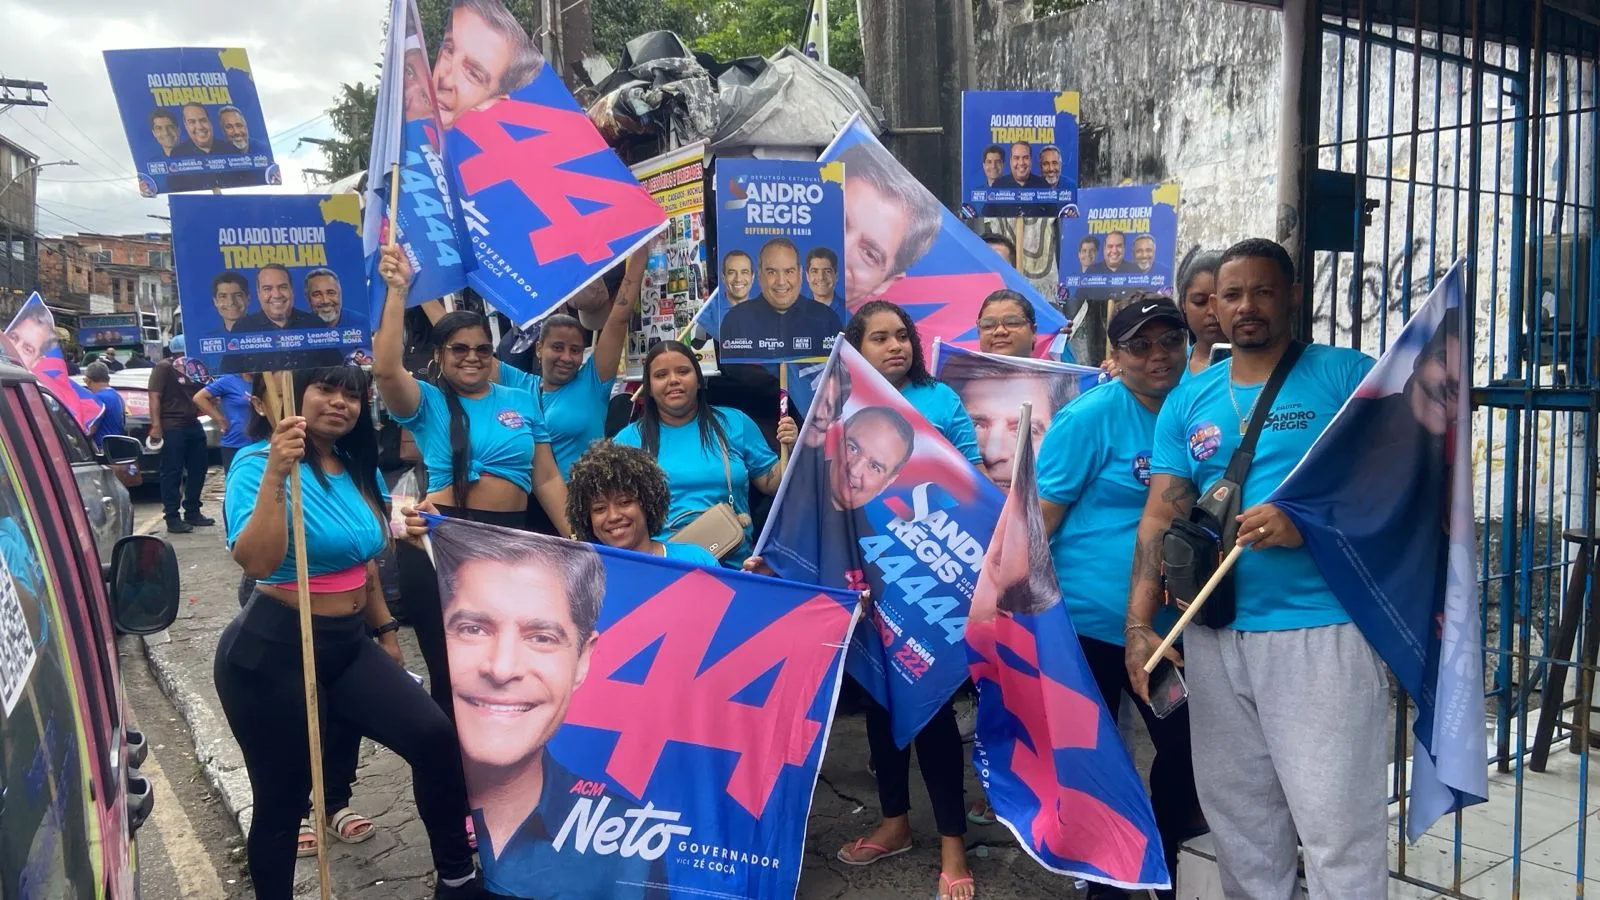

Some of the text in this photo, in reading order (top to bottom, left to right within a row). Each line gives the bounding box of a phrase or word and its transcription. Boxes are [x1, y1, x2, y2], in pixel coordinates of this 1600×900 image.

[148, 72, 228, 87] AO LADO DE QUEM
[151, 87, 233, 106] TRABALHA
[991, 115, 1055, 128] AO LADO DE QUEM
[991, 128, 1055, 143] TRABALHA
[458, 99, 668, 265] 44
[747, 201, 812, 224] RÉGIS
[1088, 207, 1152, 219] AO LADO DE QUEM
[219, 227, 325, 245] AO LADO DE QUEM
[1088, 219, 1150, 234] TRABALHA
[220, 245, 328, 268] TRABALHA
[402, 242, 421, 273] ROMA
[472, 236, 538, 299] GOVERNADOR
[1264, 411, 1316, 429] SANDRO
[1272, 420, 1308, 432] RÉGIS
[886, 516, 963, 583] RÉGIS
[859, 535, 970, 644] 44444
[956, 583, 972, 600] ESTA
[874, 600, 903, 638] CORONEL
[896, 644, 929, 678] 222
[906, 637, 935, 666] ROMA
[564, 569, 853, 819] 44
[974, 733, 990, 789] NADOR
[569, 780, 607, 797] ACM
[552, 796, 692, 861] Neto
[678, 842, 780, 869] GOVERNADOR
[693, 858, 705, 869] ZÉ
[708, 860, 736, 874] COCÁ
